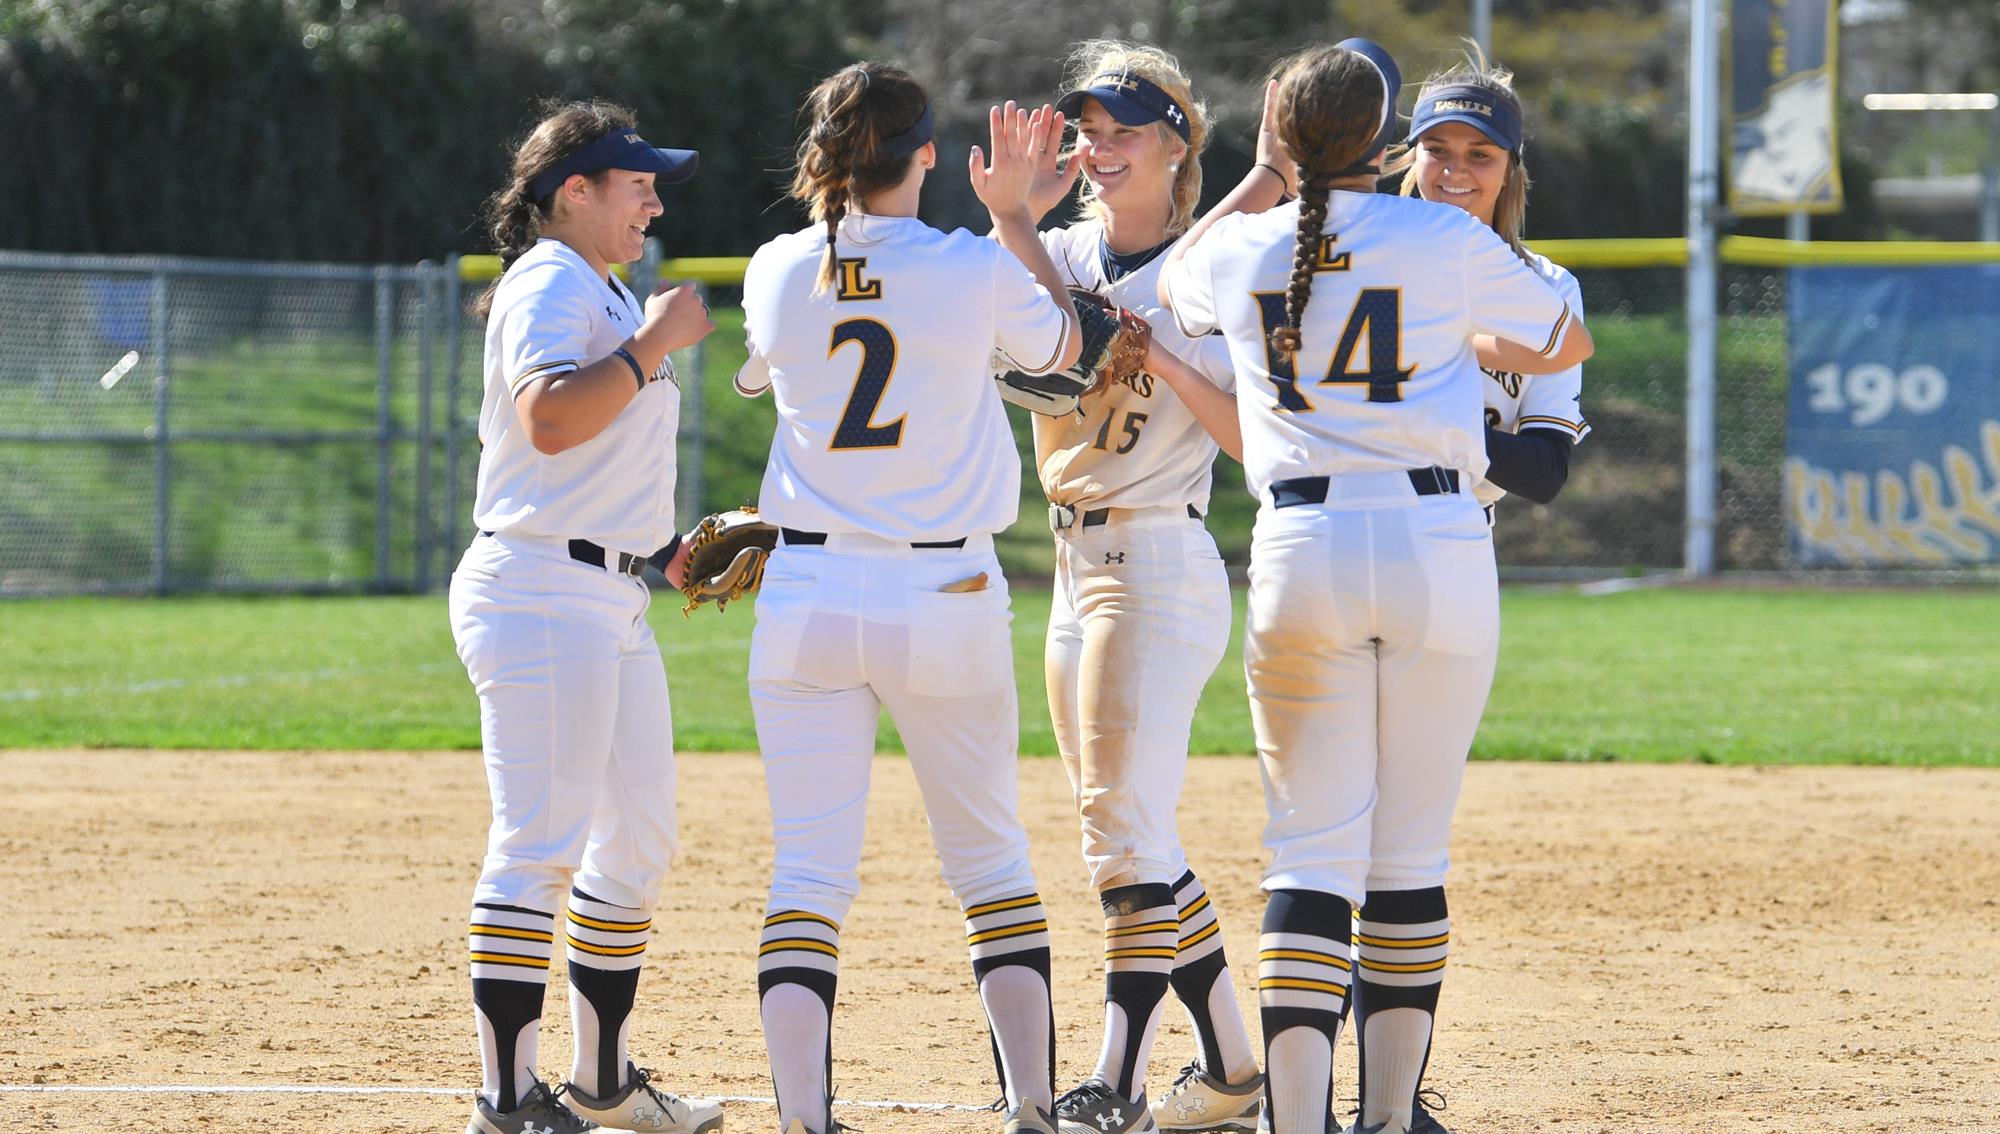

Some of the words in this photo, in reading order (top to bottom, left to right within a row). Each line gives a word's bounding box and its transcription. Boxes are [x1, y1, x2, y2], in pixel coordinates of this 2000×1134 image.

[836, 256, 883, 301] L
[1249, 286, 1420, 413] 14
[826, 315, 909, 452] 2
[1807, 361, 1949, 427] 190
[1092, 407, 1149, 455] 15
